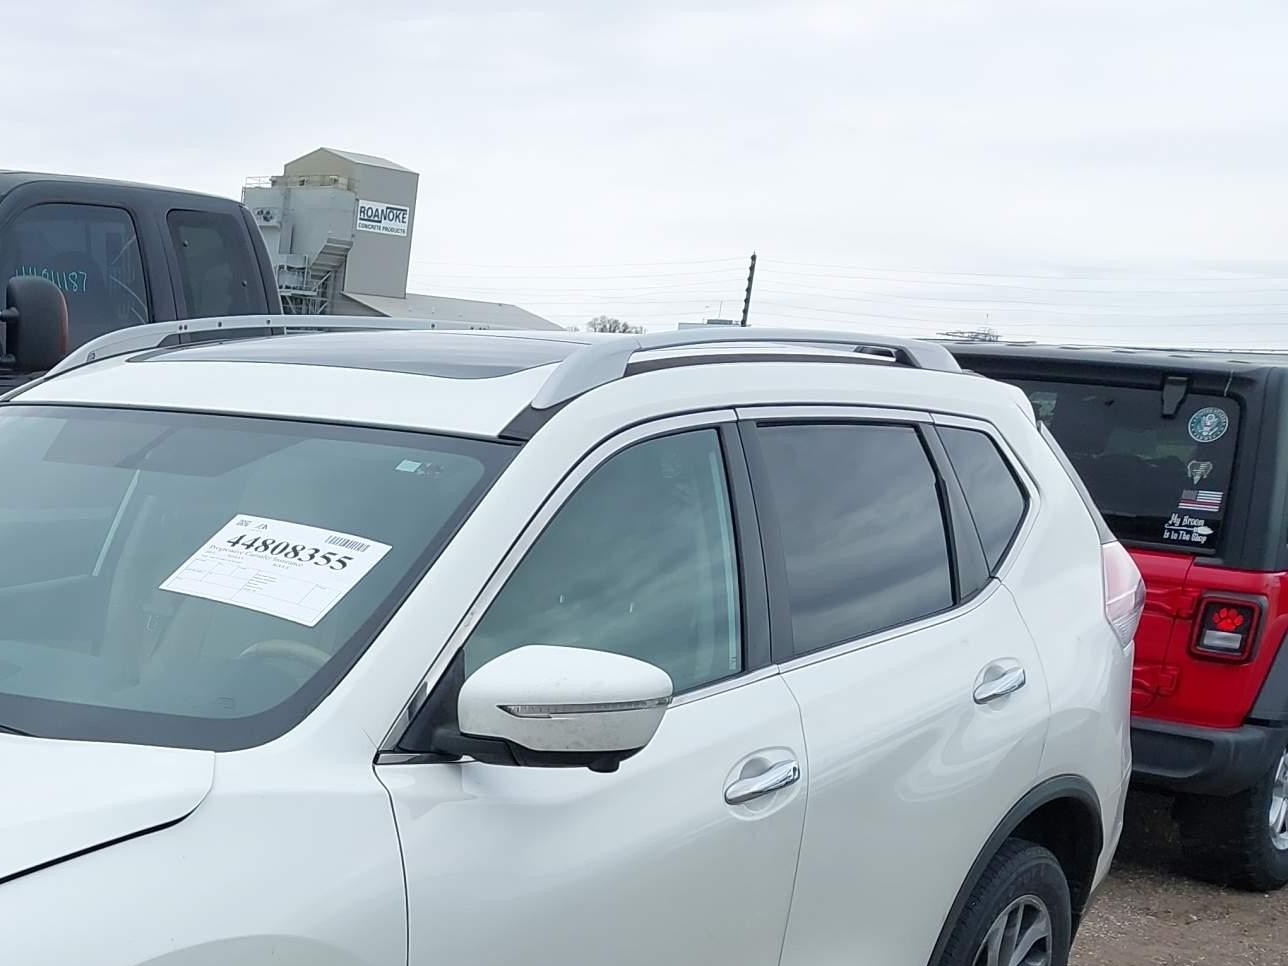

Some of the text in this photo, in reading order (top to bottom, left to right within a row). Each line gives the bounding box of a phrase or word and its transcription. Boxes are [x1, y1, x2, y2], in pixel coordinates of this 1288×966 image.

[359, 205, 408, 224] ROANOKE
[358, 222, 406, 234] CONCRETE PRODUCTS
[1168, 513, 1205, 526] My Broom
[1163, 529, 1207, 544] Is In The Shop
[226, 534, 355, 571] 44808355
